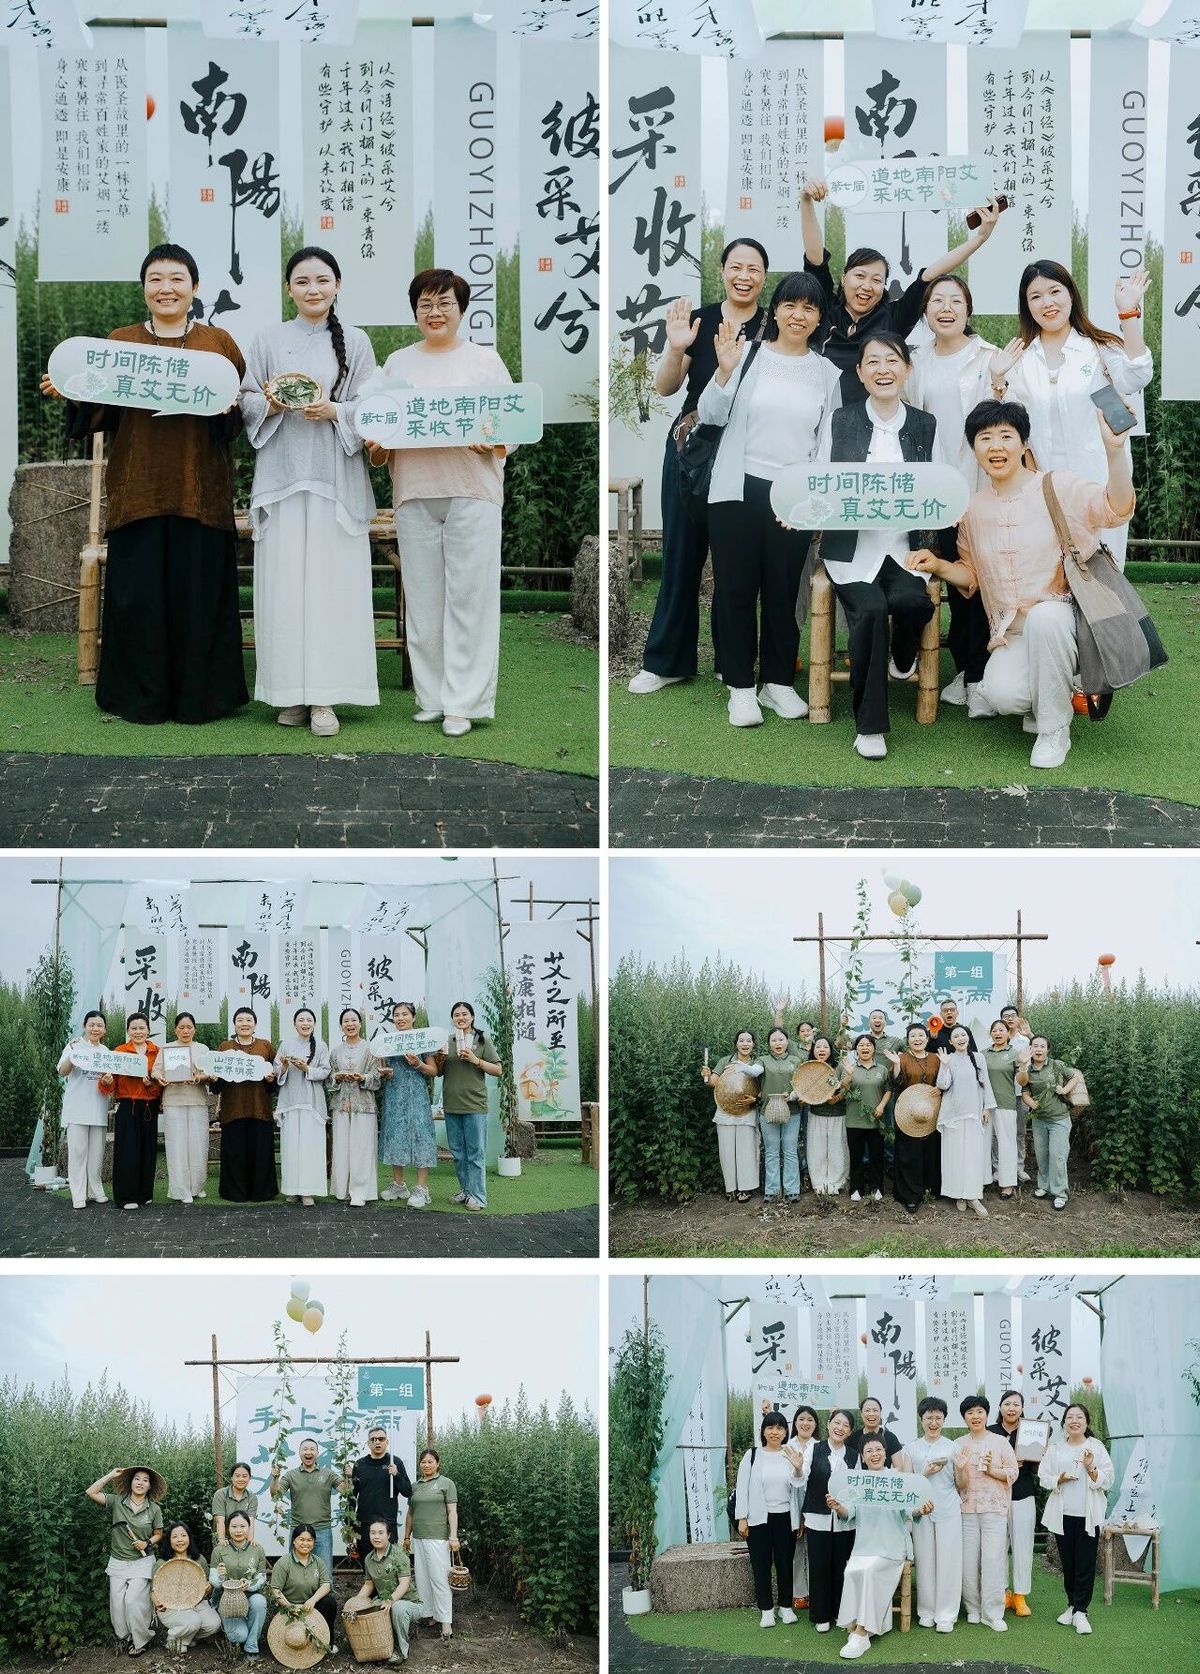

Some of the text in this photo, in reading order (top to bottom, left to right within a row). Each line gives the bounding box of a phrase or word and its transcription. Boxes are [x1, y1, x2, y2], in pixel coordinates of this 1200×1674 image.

[318, 63, 333, 133] 有些守护
[1002, 70, 1016, 135] 千年过去
[338, 61, 355, 211] 千年过去 我们相信
[831, 180, 865, 193] 第七届
[872, 164, 979, 187] 道地南阳艾
[873, 185, 934, 204] 采收节
[86, 349, 190, 379] 时间陈储
[112, 374, 217, 407] 真艾无价
[360, 411, 398, 426] 第七届
[406, 394, 526, 420] 道地南阳艾
[406, 417, 476, 440] 采收节
[807, 471, 916, 495] 时间陈储
[839, 497, 947, 522] 真艾无价
[945, 965, 984, 978] 第一组
[541, 951, 572, 1050] 艾之所至
[370, 1383, 413, 1397] 第一组
[847, 1475, 904, 1489] 时间陈储
[863, 1488, 919, 1504] 真艾无价
